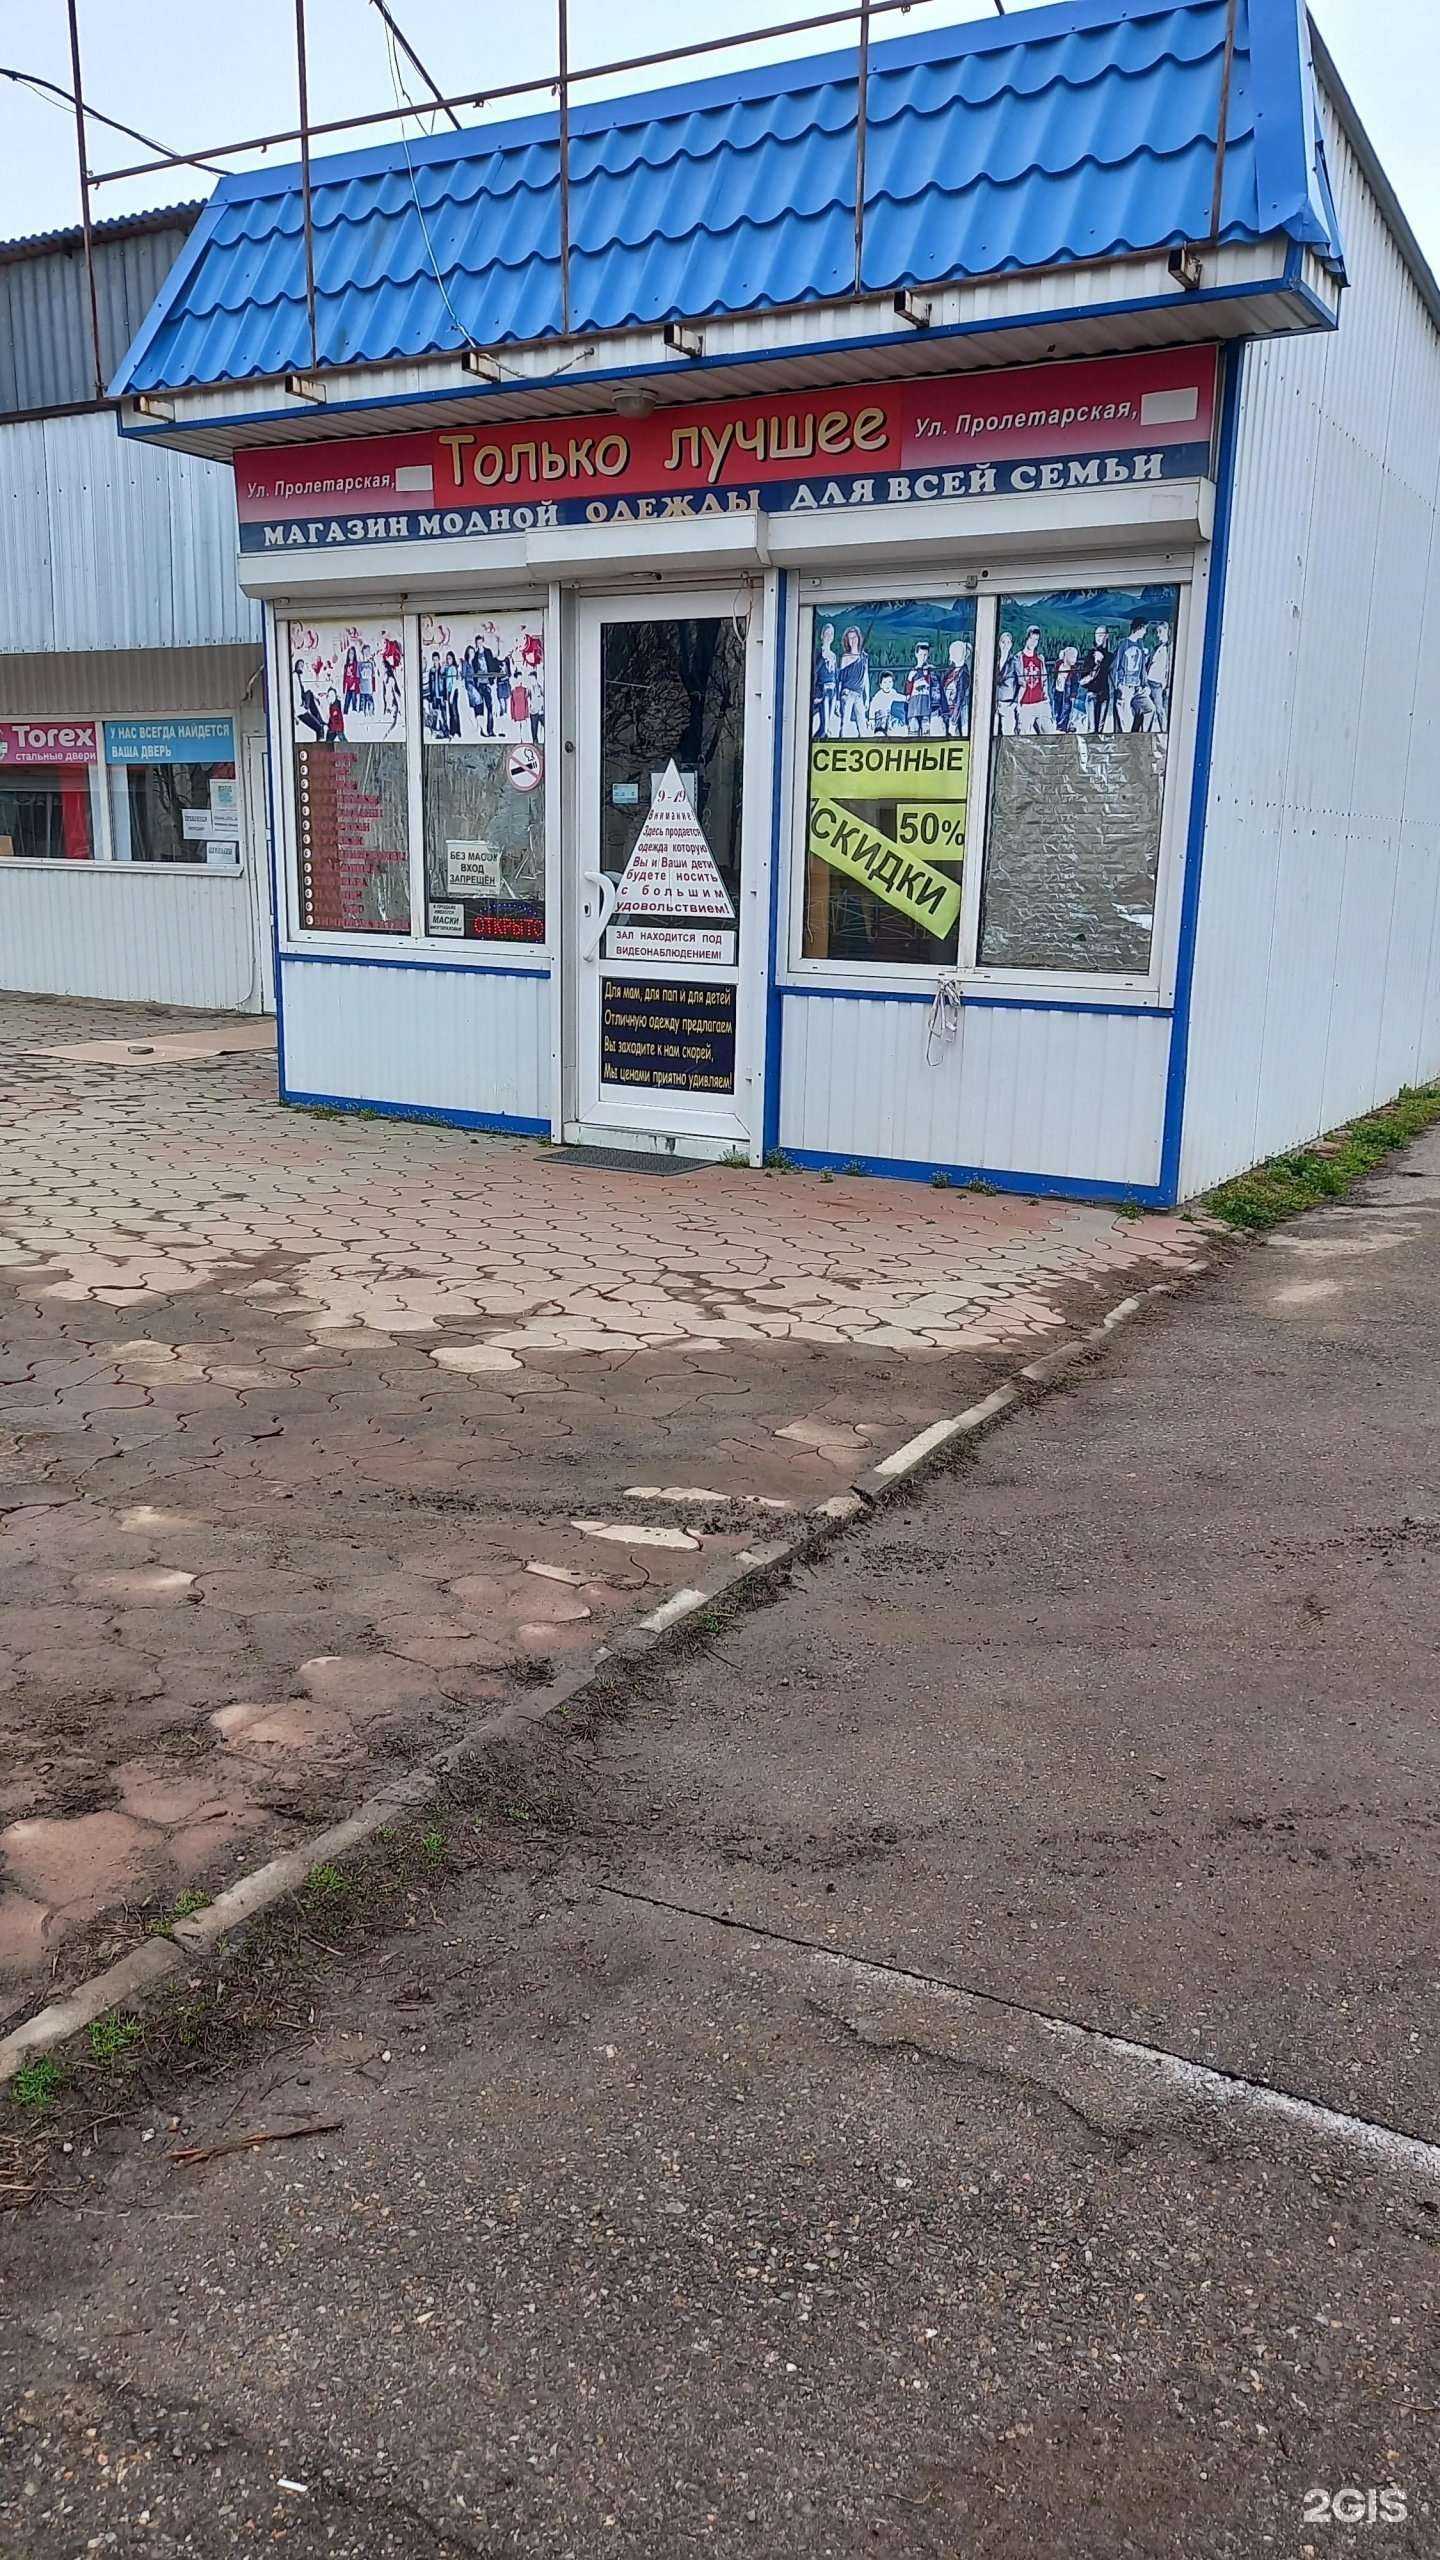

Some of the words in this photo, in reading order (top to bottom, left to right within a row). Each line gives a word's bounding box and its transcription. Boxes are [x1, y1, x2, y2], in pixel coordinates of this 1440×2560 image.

[914, 418, 948, 439] Ул.
[955, 400, 1138, 438] Пролетарская,
[439, 433, 632, 486] Только
[663, 406, 888, 484] лучшее
[247, 481, 270, 498] Ул.
[274, 473, 395, 498] Пролетарская,
[264, 516, 409, 547] МАГАЗИН
[417, 498, 560, 536] МОДНОЙ
[585, 489, 762, 525] ОДЕЖДЫ
[789, 478, 875, 511] ДЛЯ
[887, 463, 997, 501] ВСЕЙ
[1010, 453, 1165, 491] СЕМЬИ
[12, 725, 95, 748] Torex
[110, 728, 117, 739] У
[119, 727, 138, 739] НАС
[139, 725, 177, 740] ВСЕГДА
[178, 723, 230, 739] НАЙДЕТСЯ
[15, 752, 63, 761] стальные
[65, 752, 96, 762] двери
[112, 745, 139, 758] ВАША
[140, 745, 172, 760] ДВЕРЬ
[813, 748, 964, 773] СЕЗОННЫЕ
[643, 825, 663, 837] Здесь
[665, 826, 701, 838] продается
[899, 812, 966, 846] 50%
[450, 851, 466, 860] БЕЗ
[638, 843, 668, 855] одежда
[672, 844, 708, 856] которую
[460, 863, 485, 874] ВХОД
[633, 856, 648, 867] Вы
[652, 859, 658, 867] и
[662, 857, 688, 868] Ваши
[691, 859, 714, 870] дети
[811, 808, 948, 915] СКИДКИ
[626, 869, 667, 881] будете
[676, 872, 719, 882] носить
[621, 887, 628, 895] с
[642, 886, 724, 898] большим
[615, 901, 730, 914] удовольствием!
[433, 915, 460, 925] МАСКИ
[616, 931, 634, 940] ЗАЛ
[640, 932, 696, 943] НАХОДИТСЯ
[702, 935, 723, 945] ПОД
[616, 946, 722, 960] ВИДЕОНАБЛЮДЕНИЕМ!
[605, 981, 621, 999] Для
[644, 987, 660, 1000] для
[662, 989, 678, 1002] пап
[680, 988, 686, 1002] и
[688, 990, 704, 1003] для
[705, 988, 731, 1006] детей
[604, 1009, 647, 1032] Отличную
[649, 1016, 680, 1034] одежду
[682, 1017, 733, 1035] предлагаем
[604, 1036, 617, 1052] Вы
[618, 1040, 656, 1056] заходите
[657, 1043, 663, 1053] к
[664, 1044, 681, 1057] нам
[682, 1044, 714, 1064] скорей,
[604, 1063, 618, 1079] Мы
[620, 1067, 651, 1082] ценами
[652, 1071, 687, 1087] приятно
[689, 1071, 733, 1090] удивляем!
